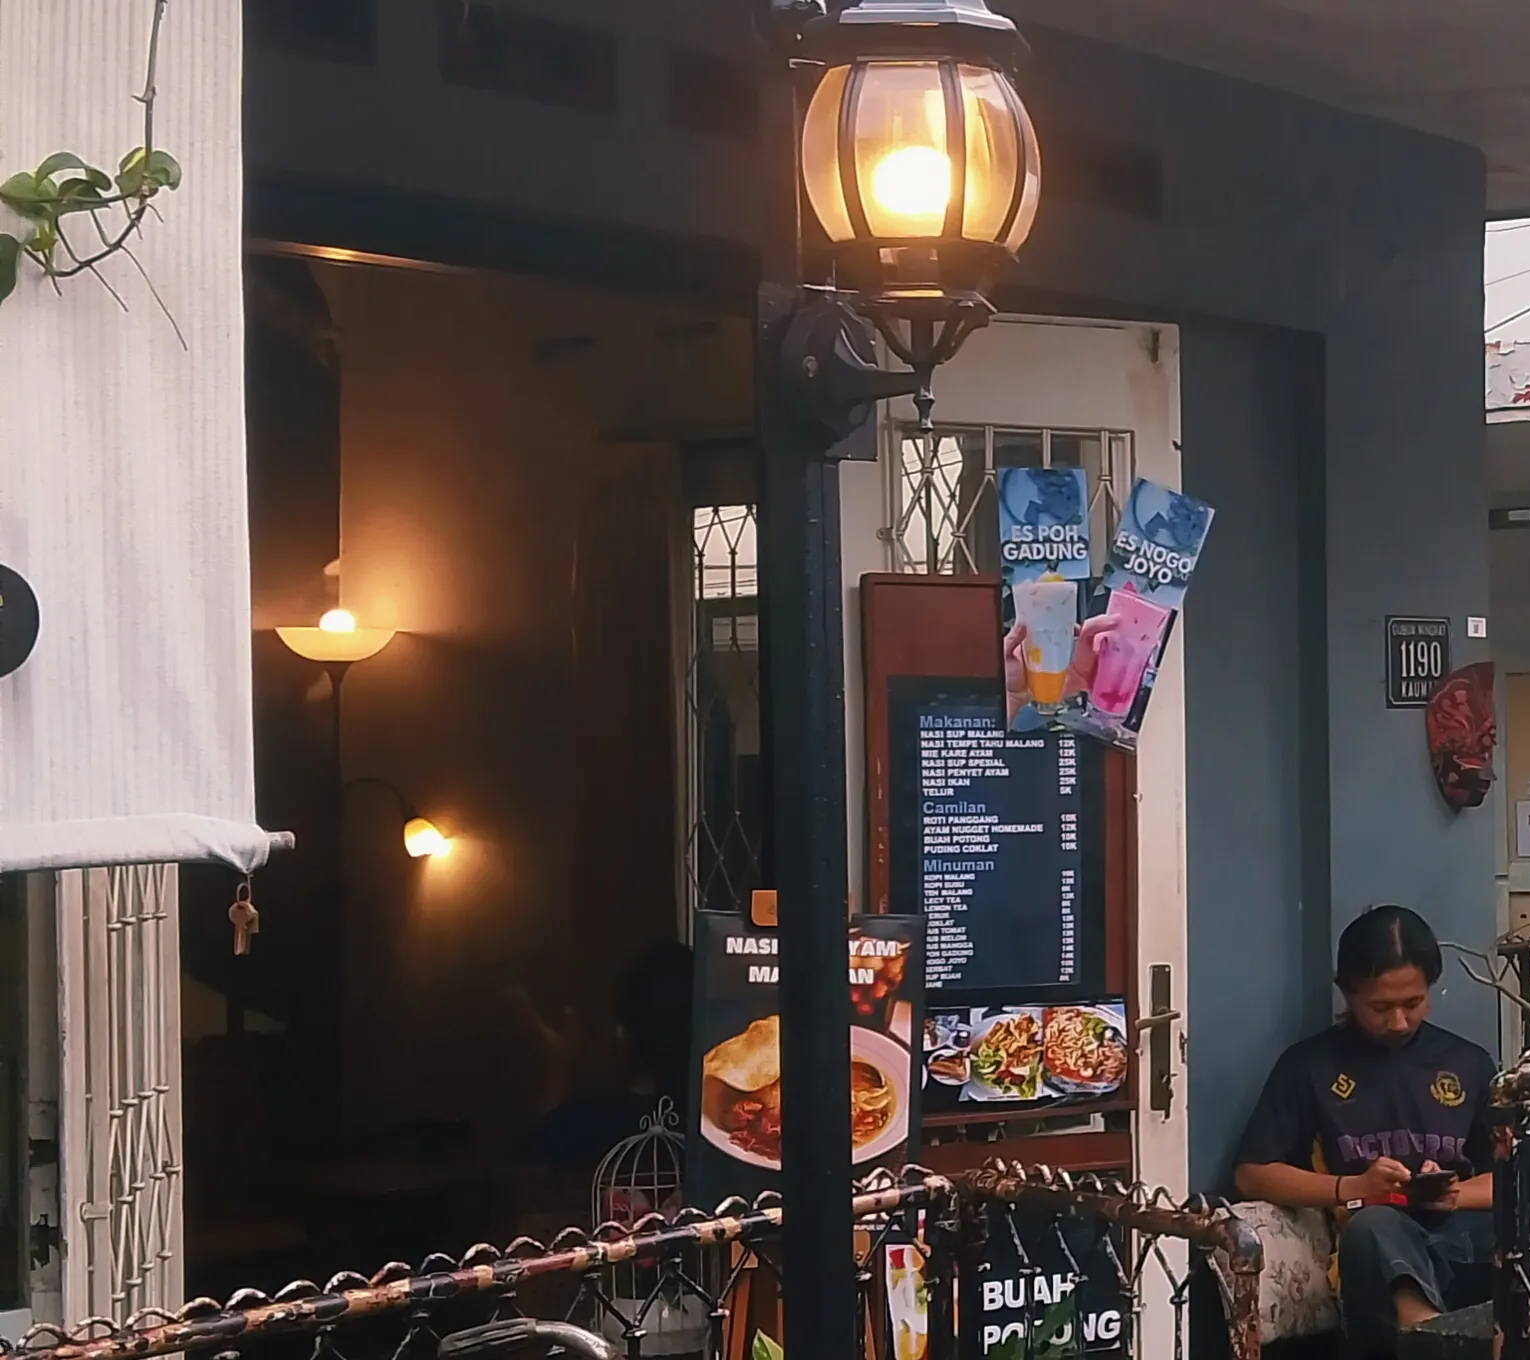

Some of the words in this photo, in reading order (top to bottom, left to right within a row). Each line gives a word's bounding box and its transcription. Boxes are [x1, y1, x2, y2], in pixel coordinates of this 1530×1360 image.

[1011, 525, 1033, 542] ES
[1038, 525, 1079, 542] POH
[1003, 542, 1088, 560] GADUNG
[1116, 530, 1138, 552] ES
[1139, 541, 1193, 573] NOGO
[1123, 555, 1173, 584] JOYO
[1400, 640, 1441, 677] 1190
[1401, 680, 1438, 698] KAUM
[920, 716, 996, 728] Makanan:
[968, 730, 1005, 738] MALANG
[921, 740, 945, 748] NASI
[947, 740, 979, 748] TEMPE
[980, 740, 1004, 748] TAHU
[1005, 740, 1044, 748] MALANG
[921, 750, 938, 758] MIE
[941, 750, 967, 758] KARE
[969, 749, 993, 757] AYAM
[922, 759, 945, 767] NASI
[947, 759, 966, 767] SUP
[968, 759, 1005, 767] SPESIAL
[922, 769, 945, 777] NASI
[948, 769, 983, 777] PENYET
[984, 768, 1009, 777] AYAM
[922, 778, 946, 787] NASI
[923, 788, 954, 797] TELUR
[923, 802, 986, 814] Camilan
[923, 816, 946, 824] ROTI
[948, 816, 999, 824] PANGGANG
[923, 826, 950, 834] AYAM
[952, 825, 989, 834] NUGGET
[991, 824, 1044, 833] HOMEMADE
[953, 835, 990, 843] POTONG
[924, 845, 960, 854] PUDING
[962, 844, 999, 853] COKLAT
[923, 859, 995, 872] Minuman
[928, 912, 950, 920] ERUK
[726, 937, 778, 955] NASI
[849, 940, 897, 957] YAM
[983, 1272, 1076, 1311] BUAH
[983, 1310, 1121, 1355] POONG
